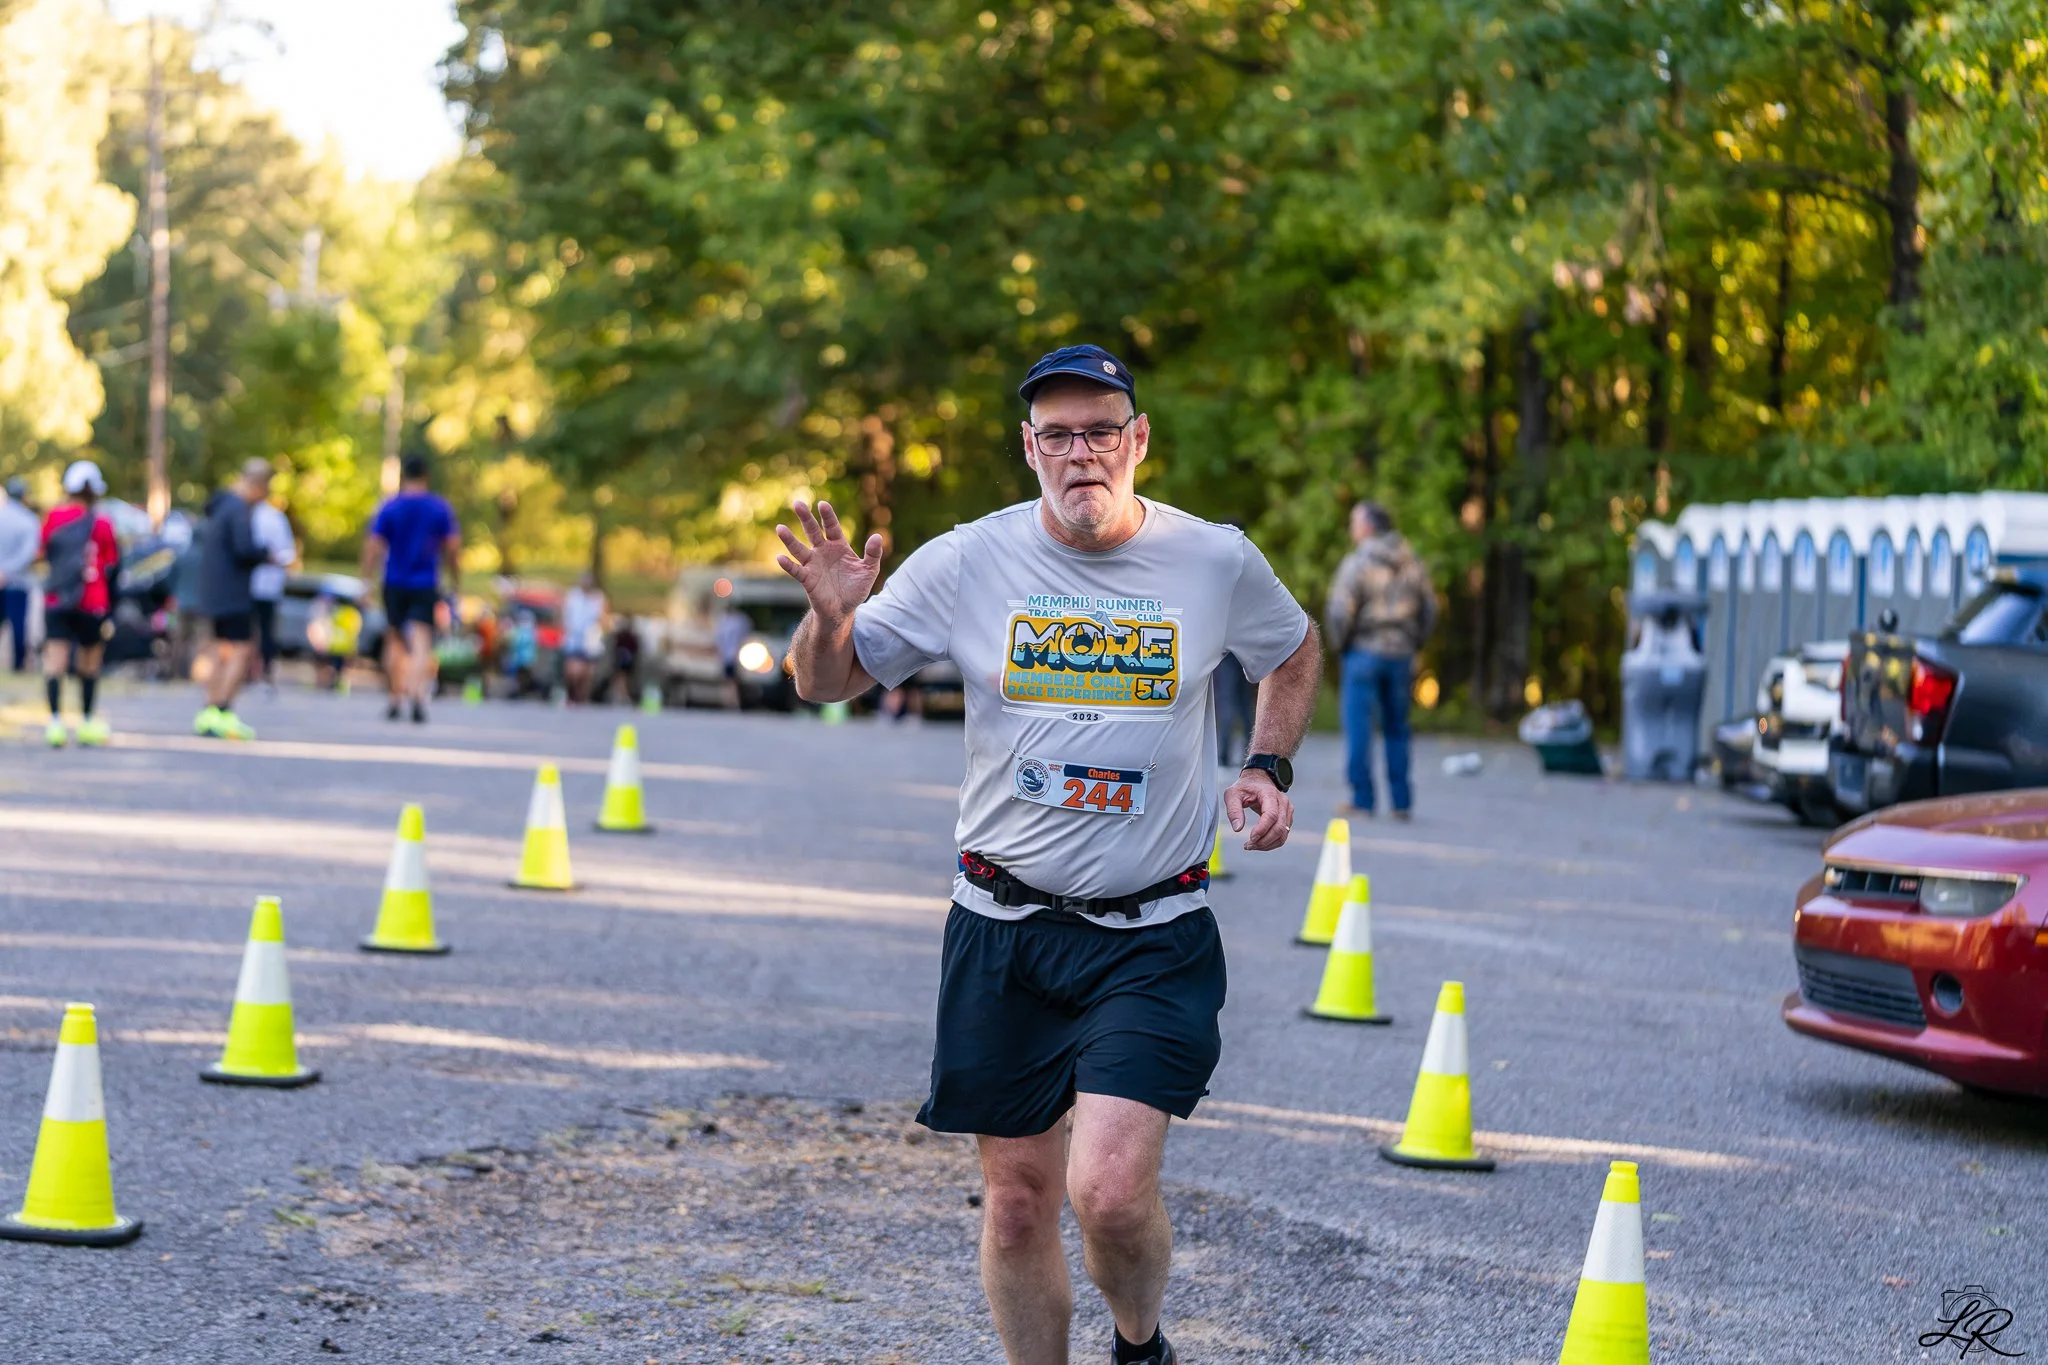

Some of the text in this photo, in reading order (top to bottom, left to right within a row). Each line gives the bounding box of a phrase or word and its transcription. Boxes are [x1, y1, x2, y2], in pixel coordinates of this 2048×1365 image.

[1028, 595, 1162, 612] MEMPHIS RUNNERS
[1028, 608, 1163, 623] TRACK CLUB
[1011, 620, 1175, 676] MORE
[1008, 672, 1135, 689] MEMBERS ONLY
[1135, 677, 1175, 700] 5K
[1007, 685, 1132, 701] RACE EXPERIENCE
[1088, 768, 1120, 781] Charles
[1061, 778, 1134, 812] 244
